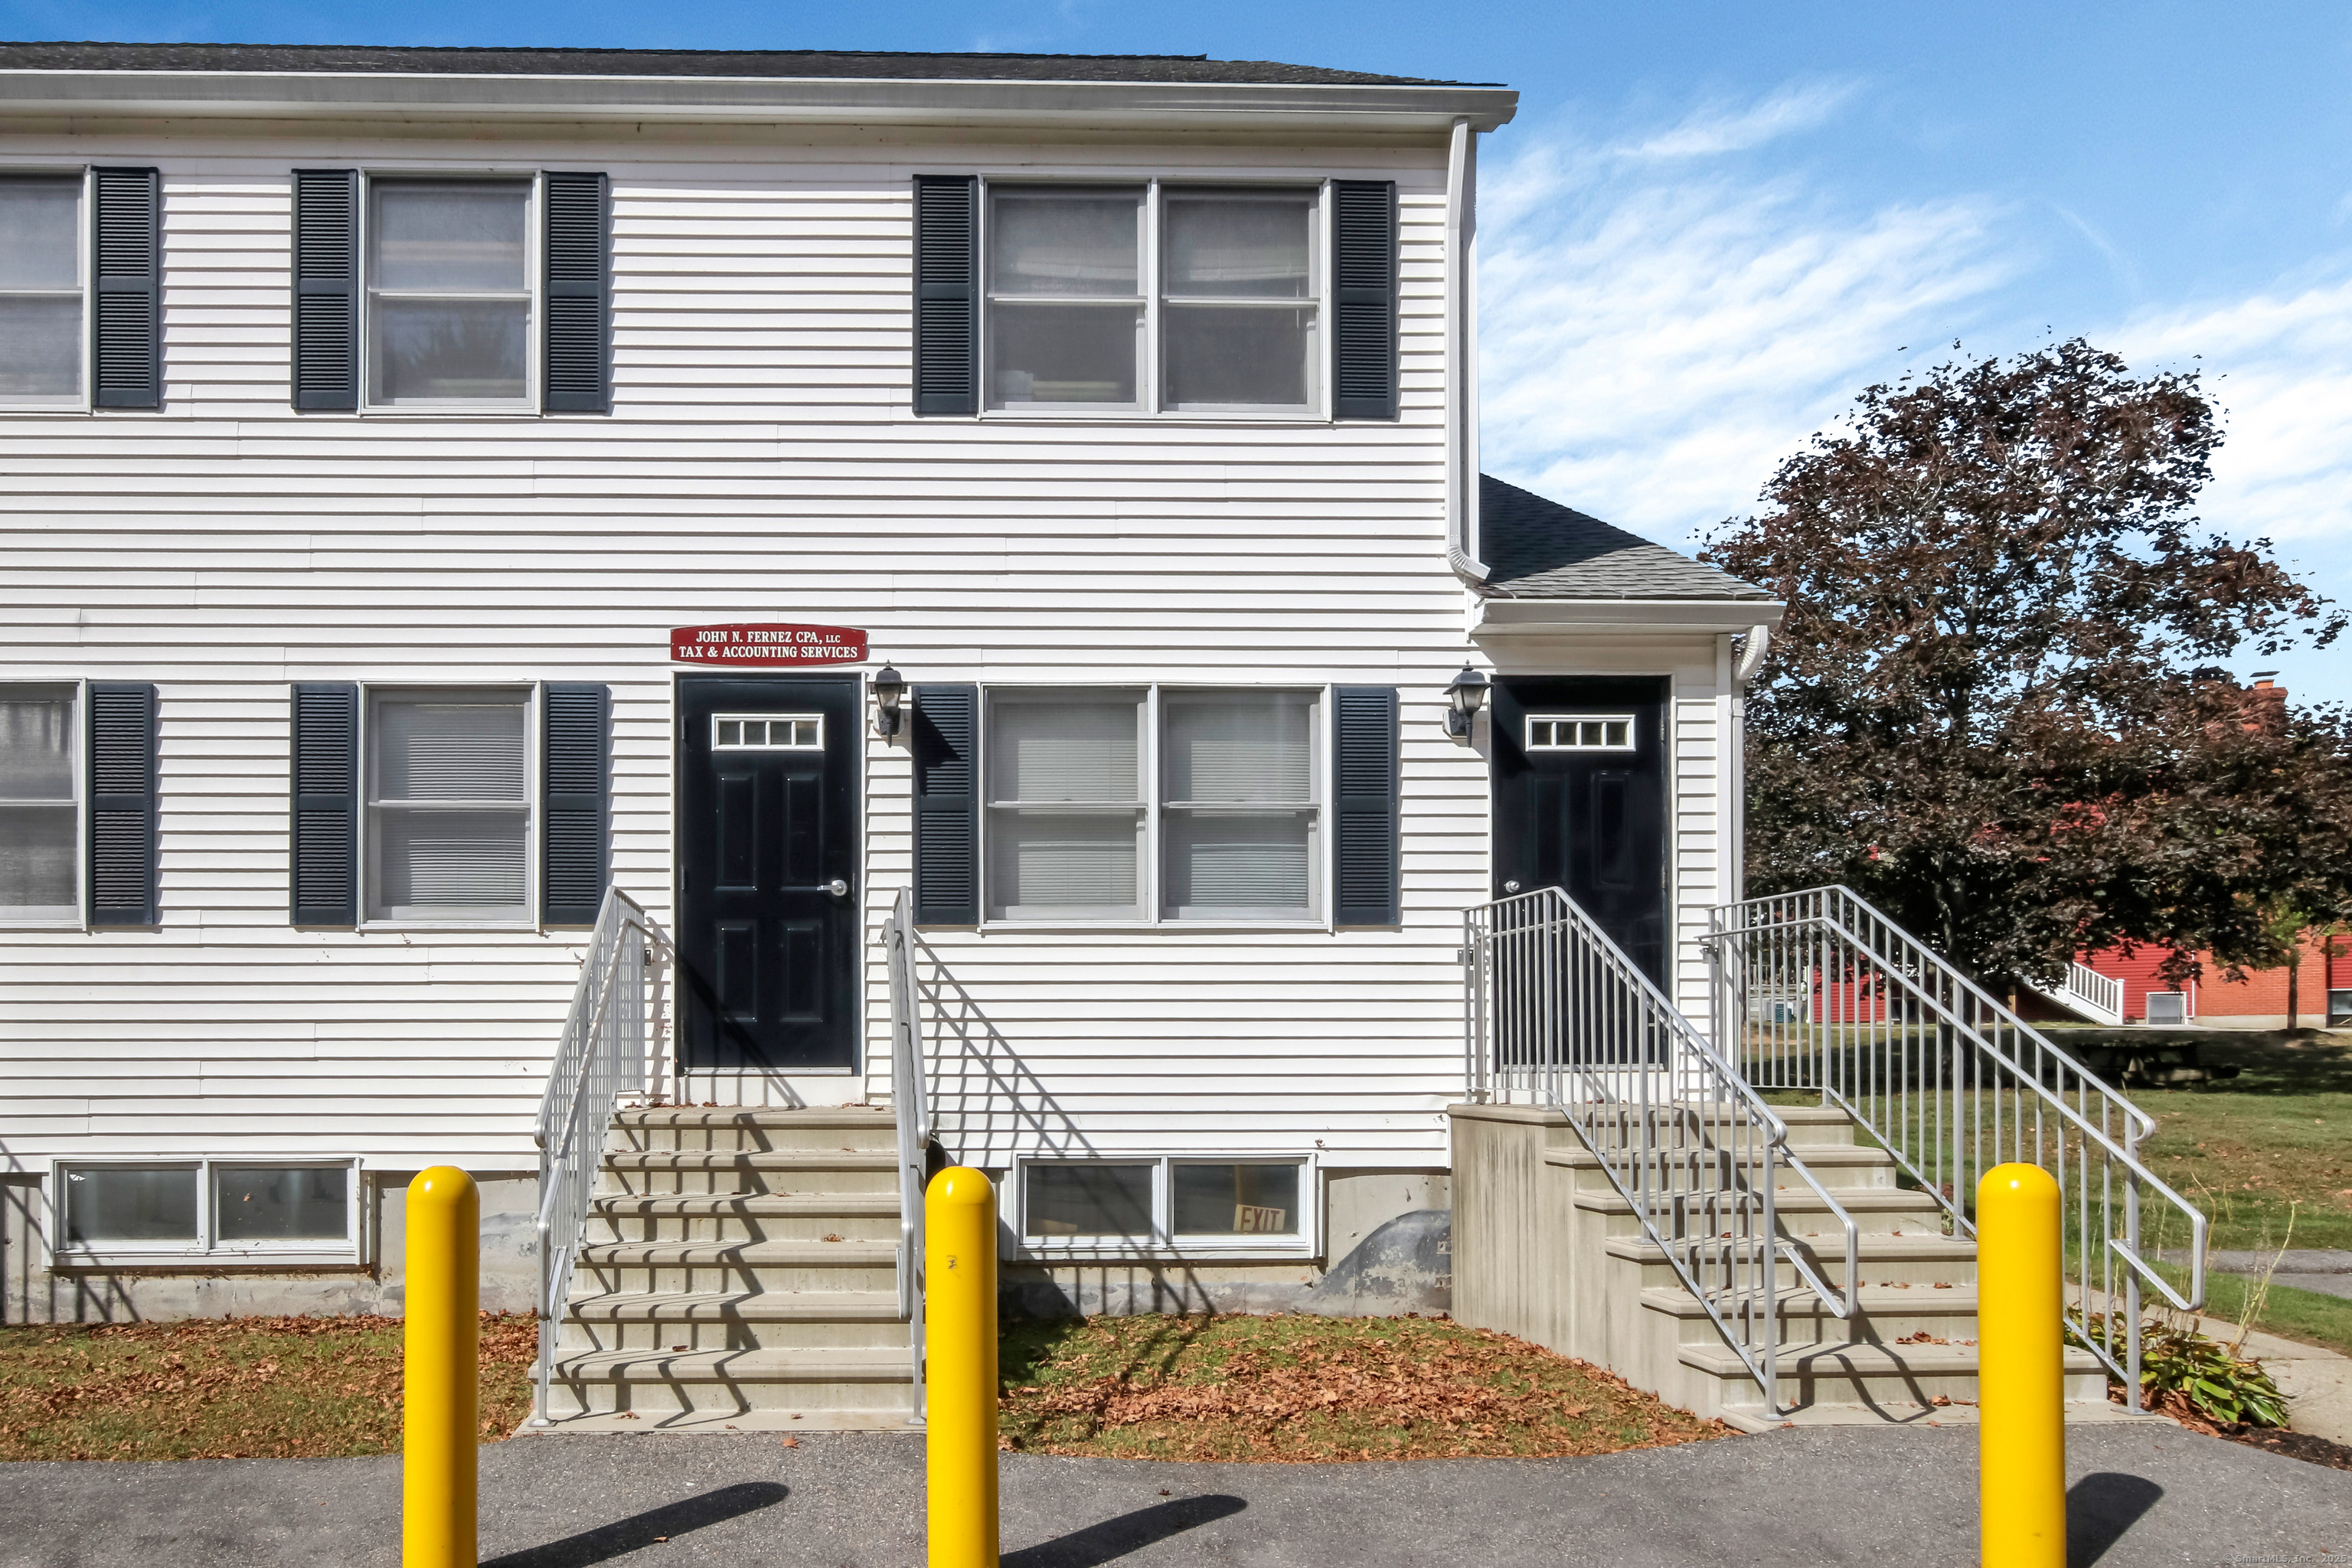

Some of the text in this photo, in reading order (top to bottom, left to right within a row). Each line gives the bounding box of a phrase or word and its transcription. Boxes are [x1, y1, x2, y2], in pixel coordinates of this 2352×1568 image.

[696, 631, 841, 645] JOHN N. FERNEZ CPA, LLC
[679, 645, 858, 658] TAX & ACCOUNTING SERVICES
[1240, 1207, 1280, 1231] EXIT
